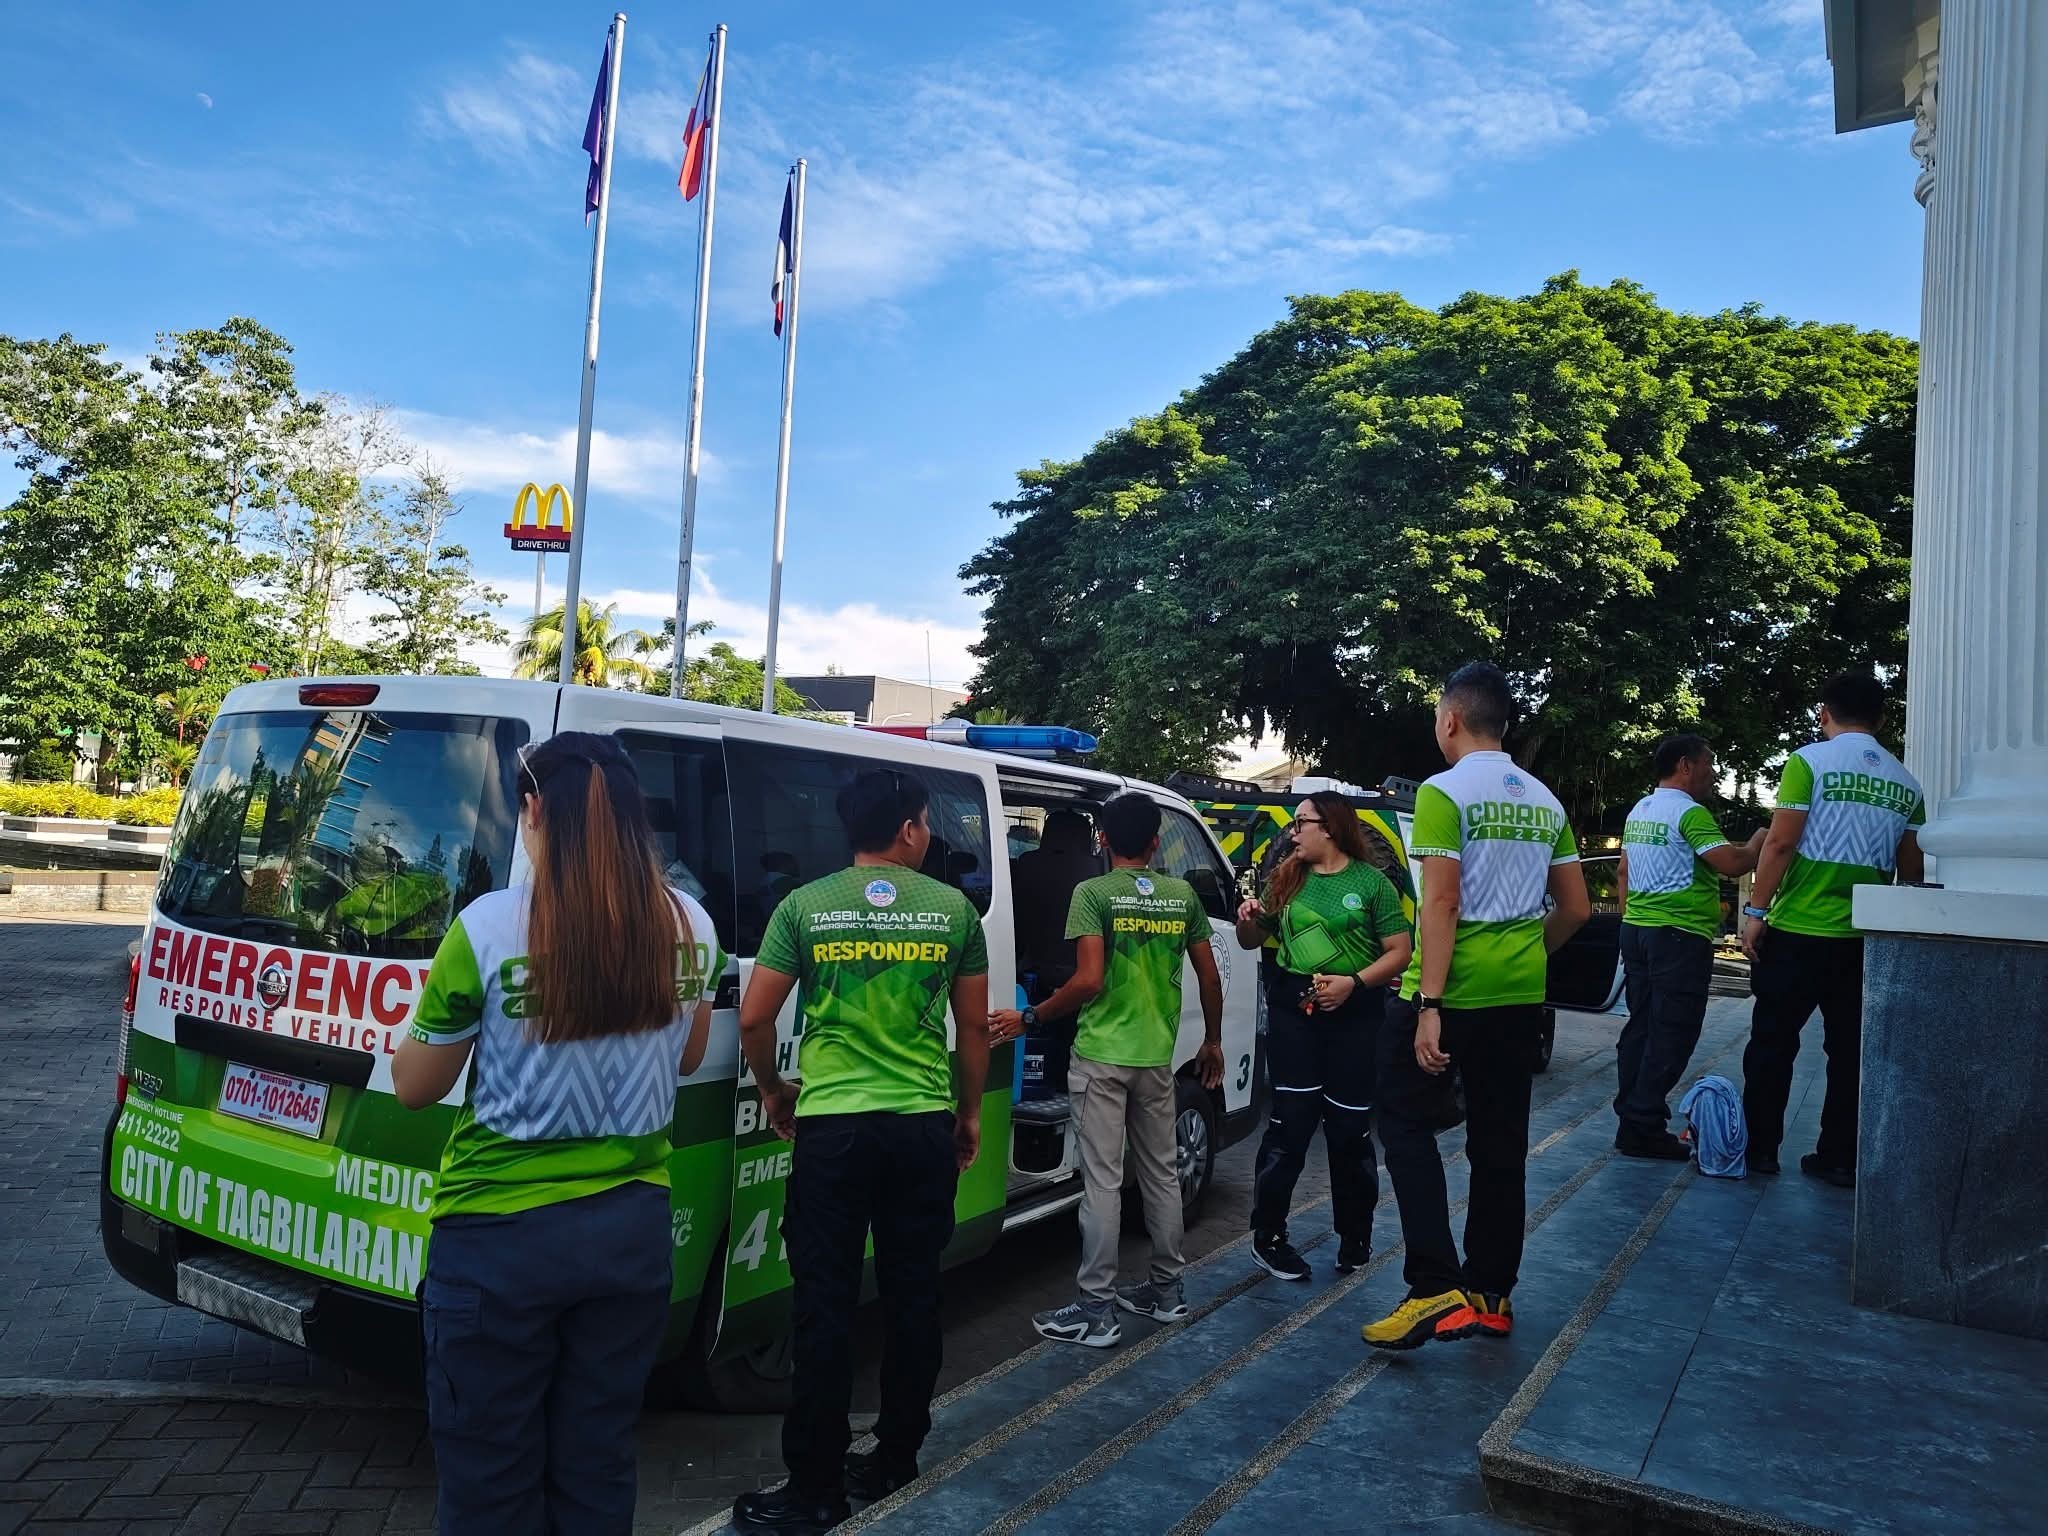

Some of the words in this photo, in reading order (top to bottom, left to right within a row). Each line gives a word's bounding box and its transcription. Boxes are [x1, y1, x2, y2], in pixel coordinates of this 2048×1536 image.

[517, 540, 566, 550] DRIVETHRU
[1823, 771, 1916, 807] CDRRMO
[810, 922, 864, 932] EMERGENCY
[866, 923, 906, 931] MEDICAL
[908, 923, 951, 932] SERVICES
[811, 911, 912, 924] TAGBILARAN
[917, 912, 952, 925] CITY
[1113, 917, 1186, 935] RESPONDER
[813, 941, 949, 963] RESPONDER
[159, 986, 274, 1032] RESPONSE
[291, 1015, 396, 1055] VEHICL
[1236, 1053, 1250, 1091] 3
[225, 1076, 320, 1124] 0701-1012645
[118, 1111, 180, 1153] 411-2222
[335, 1154, 433, 1213] MEDIC
[121, 1145, 174, 1211] CITY
[177, 1165, 211, 1225] OF
[216, 1176, 424, 1295] TAGBILARAN
